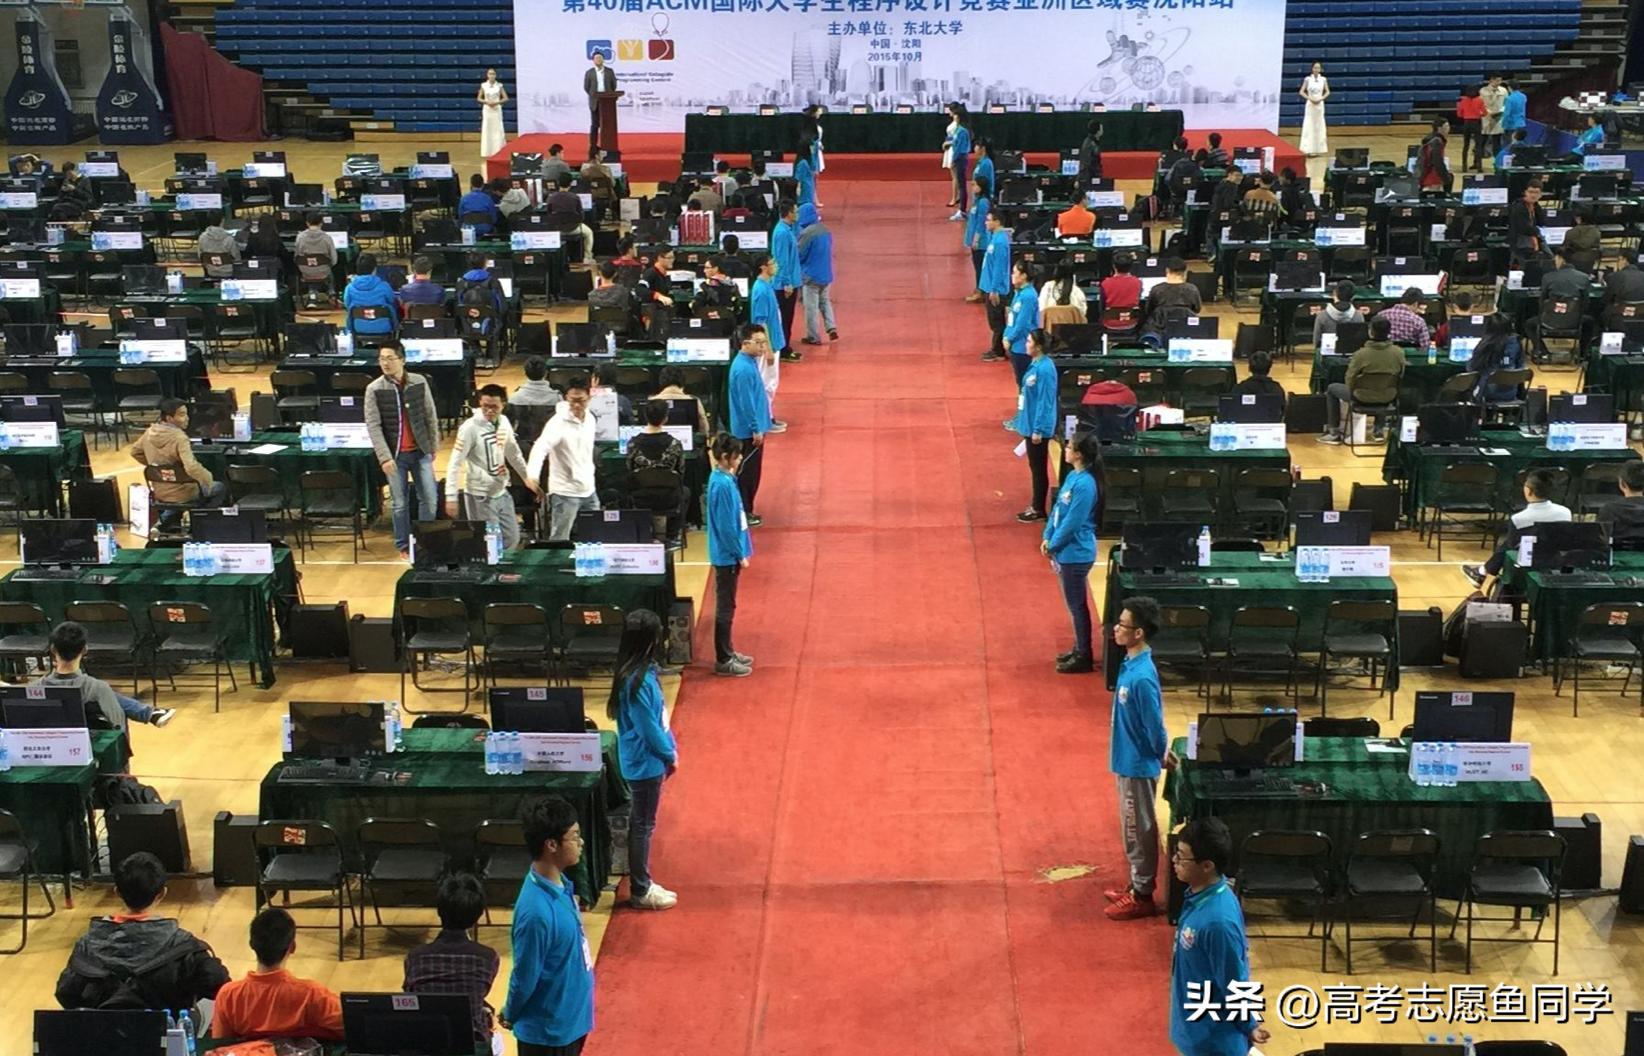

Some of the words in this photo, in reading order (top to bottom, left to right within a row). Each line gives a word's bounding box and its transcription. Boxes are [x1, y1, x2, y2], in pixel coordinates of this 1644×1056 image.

[867, 51, 923, 62] 2015年10月
[28, 688, 44, 698] 144
[529, 690, 545, 698] 145
[69, 747, 81, 757] 157
[395, 998, 416, 1007] 165
